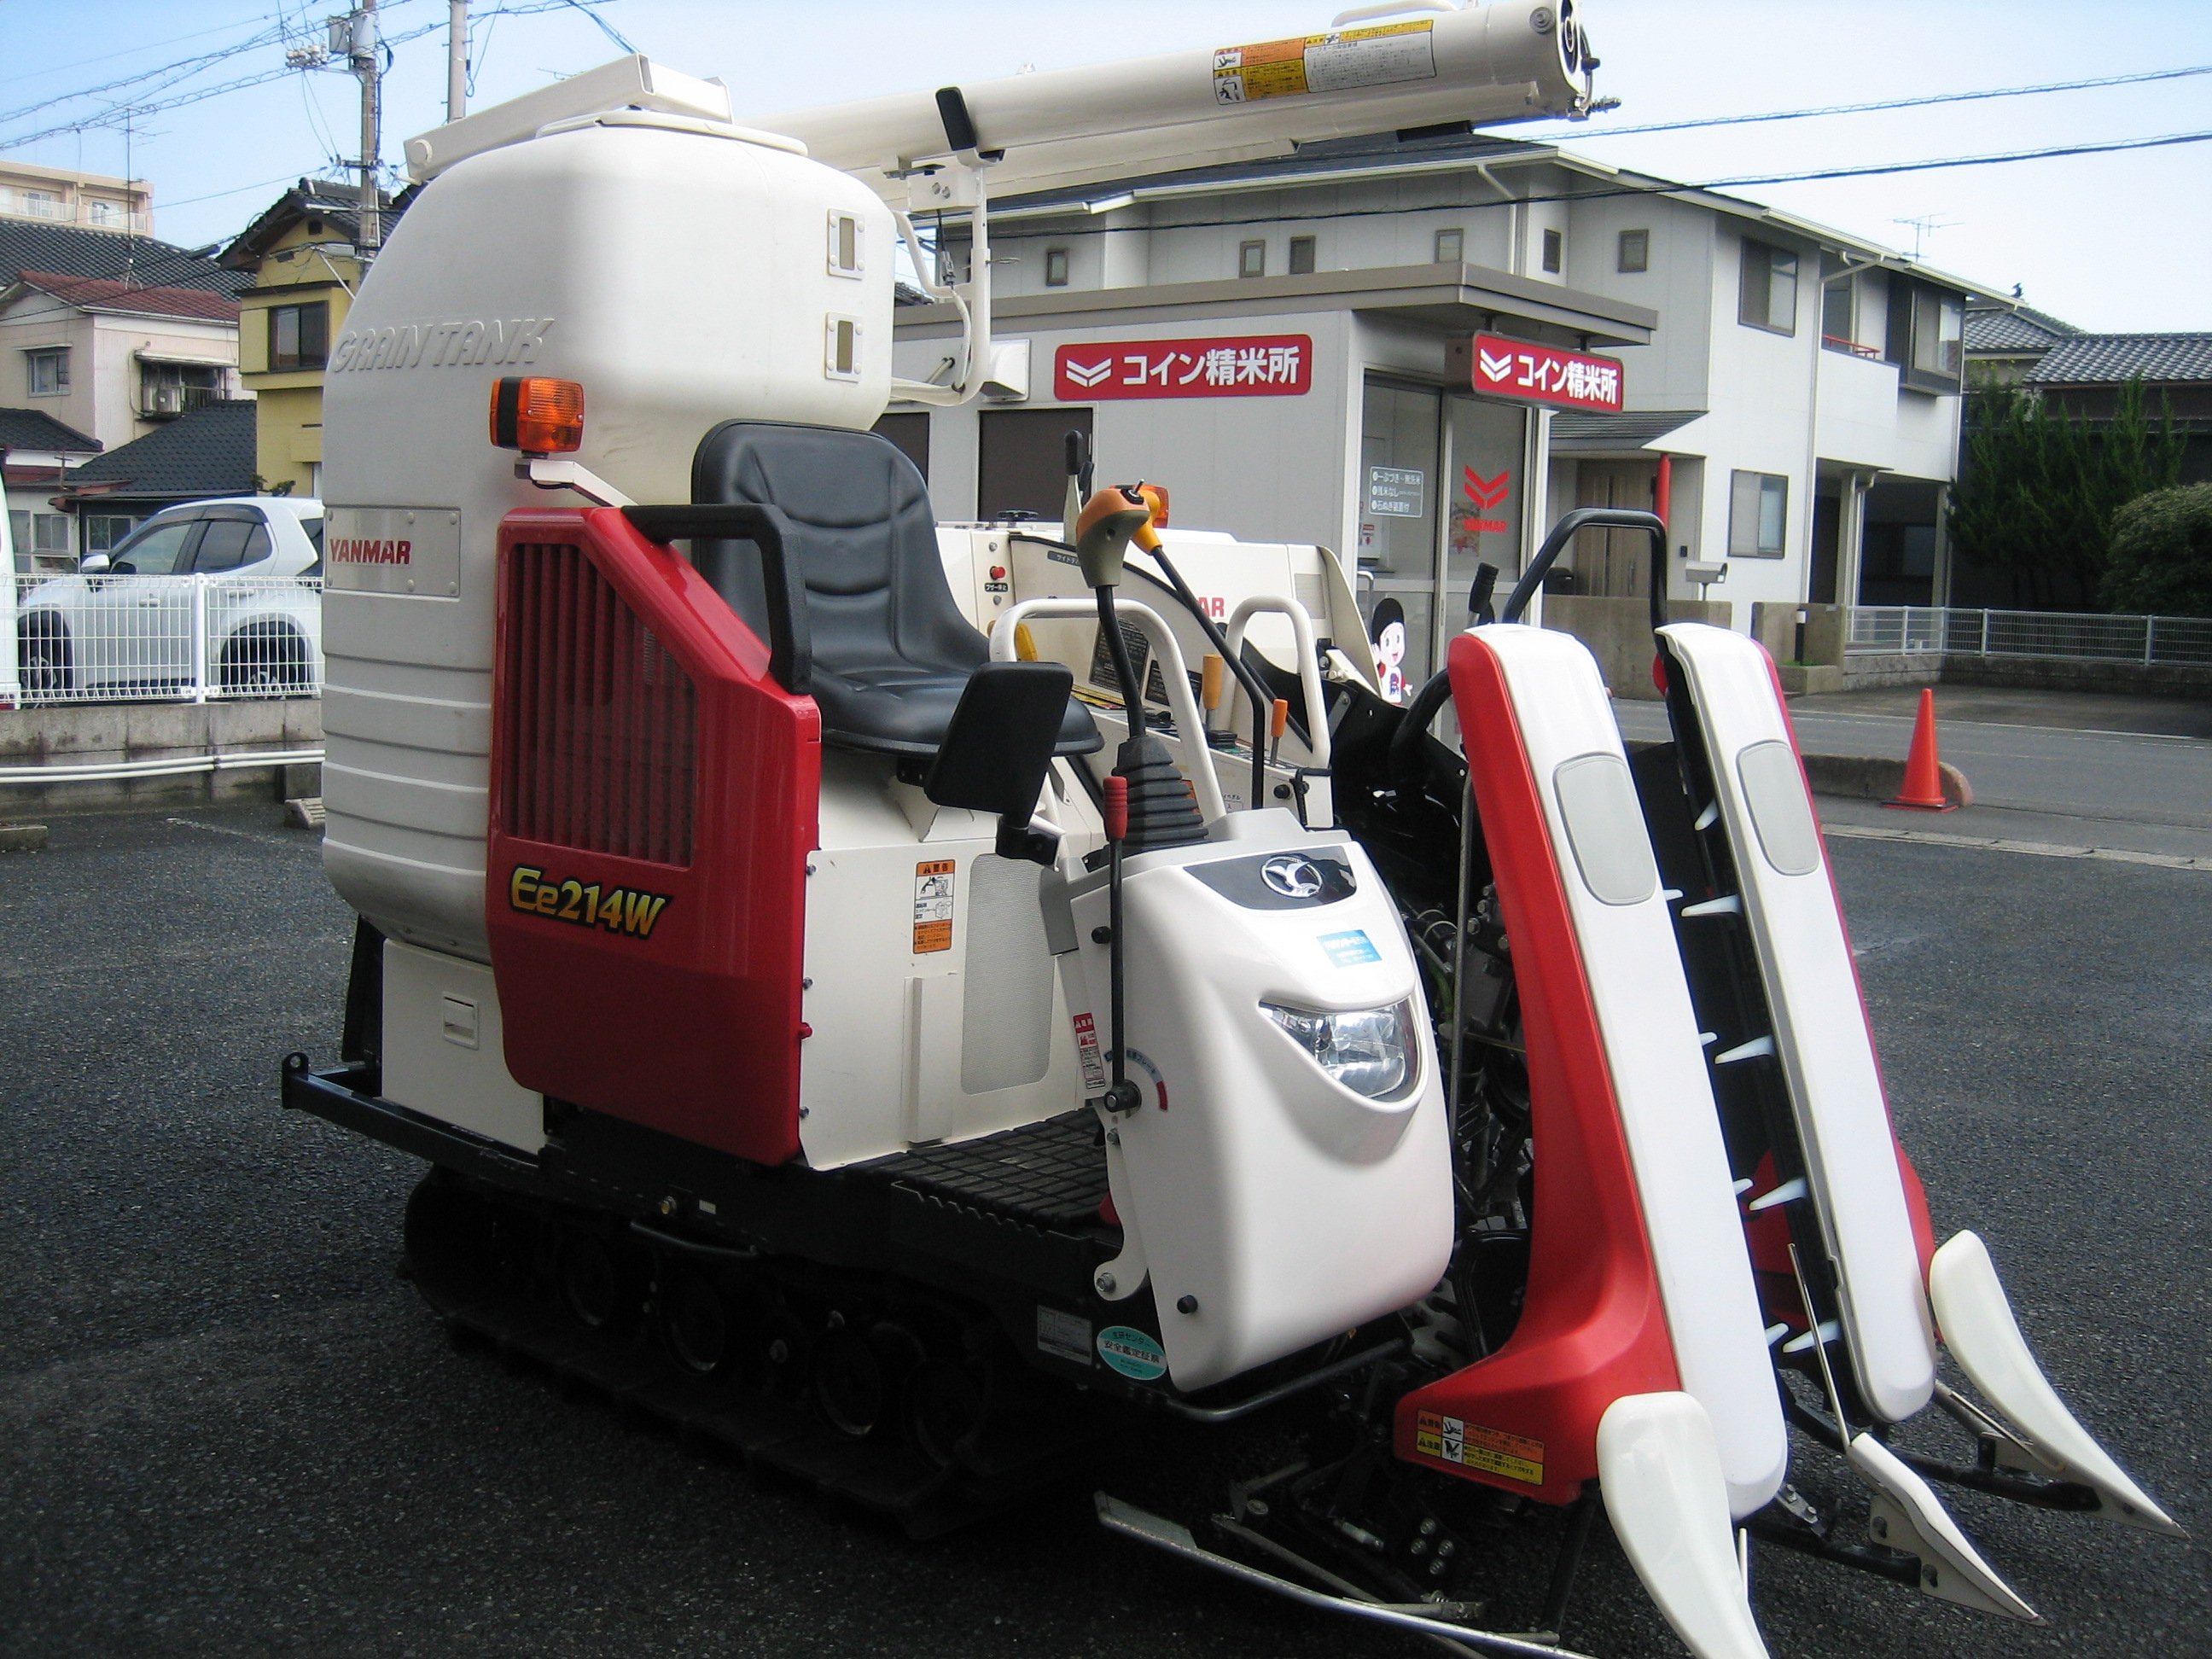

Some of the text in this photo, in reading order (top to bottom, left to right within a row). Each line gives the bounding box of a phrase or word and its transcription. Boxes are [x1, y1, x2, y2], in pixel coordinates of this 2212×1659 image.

[333, 318, 556, 373] GRAIN TANK
[1122, 345, 1300, 386] コイン精米所
[1517, 354, 1618, 405] コイン精米所
[329, 538, 411, 565] YANMAR
[512, 865, 667, 936] Ee214W
